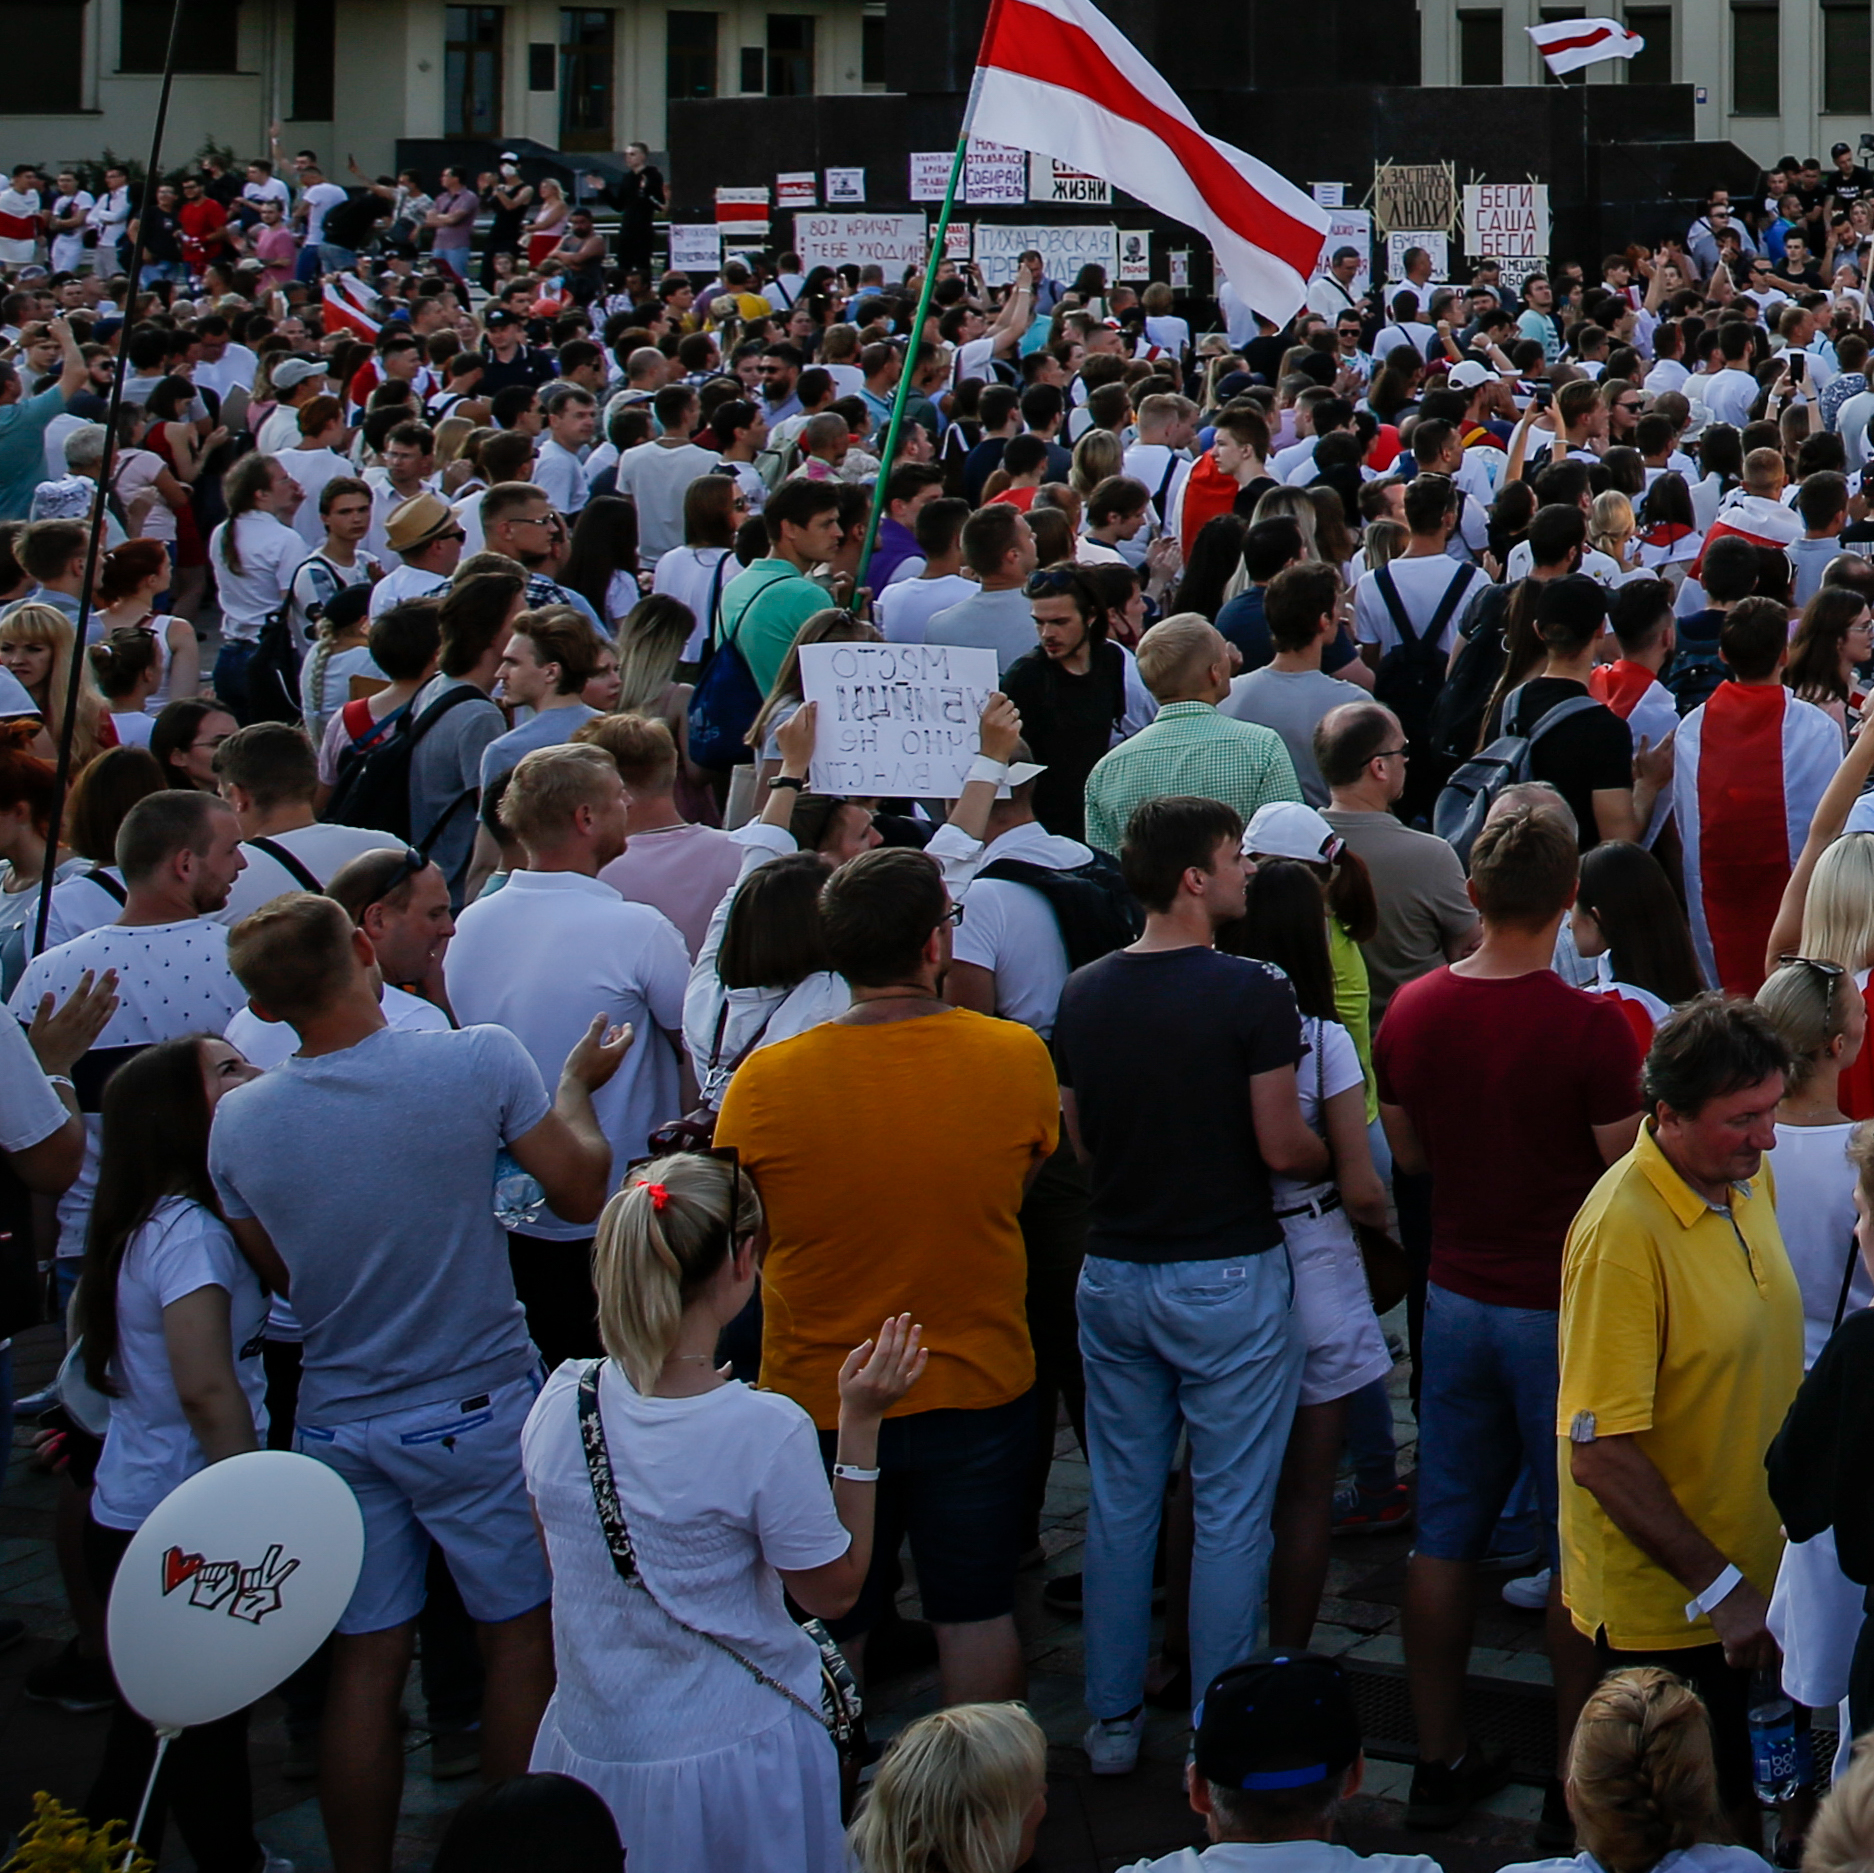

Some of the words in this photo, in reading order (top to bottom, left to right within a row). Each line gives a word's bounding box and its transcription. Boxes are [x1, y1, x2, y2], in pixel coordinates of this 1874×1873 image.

[966, 166, 1023, 185] СОБИРАЙ
[967, 186, 1025, 199] ПОРТФЕЛЬ
[1052, 180, 1106, 201] ЖИЗНИ
[1481, 186, 1533, 207] БЕГИ
[847, 218, 903, 238] КРИЧАТ
[1476, 209, 1536, 231] САША
[980, 228, 1111, 252] ТИХАНОВСКАЯ
[1481, 233, 1533, 256] БЕГИ
[811, 242, 849, 258] ТЕБЕ
[857, 242, 918, 262] УХОДИ!
